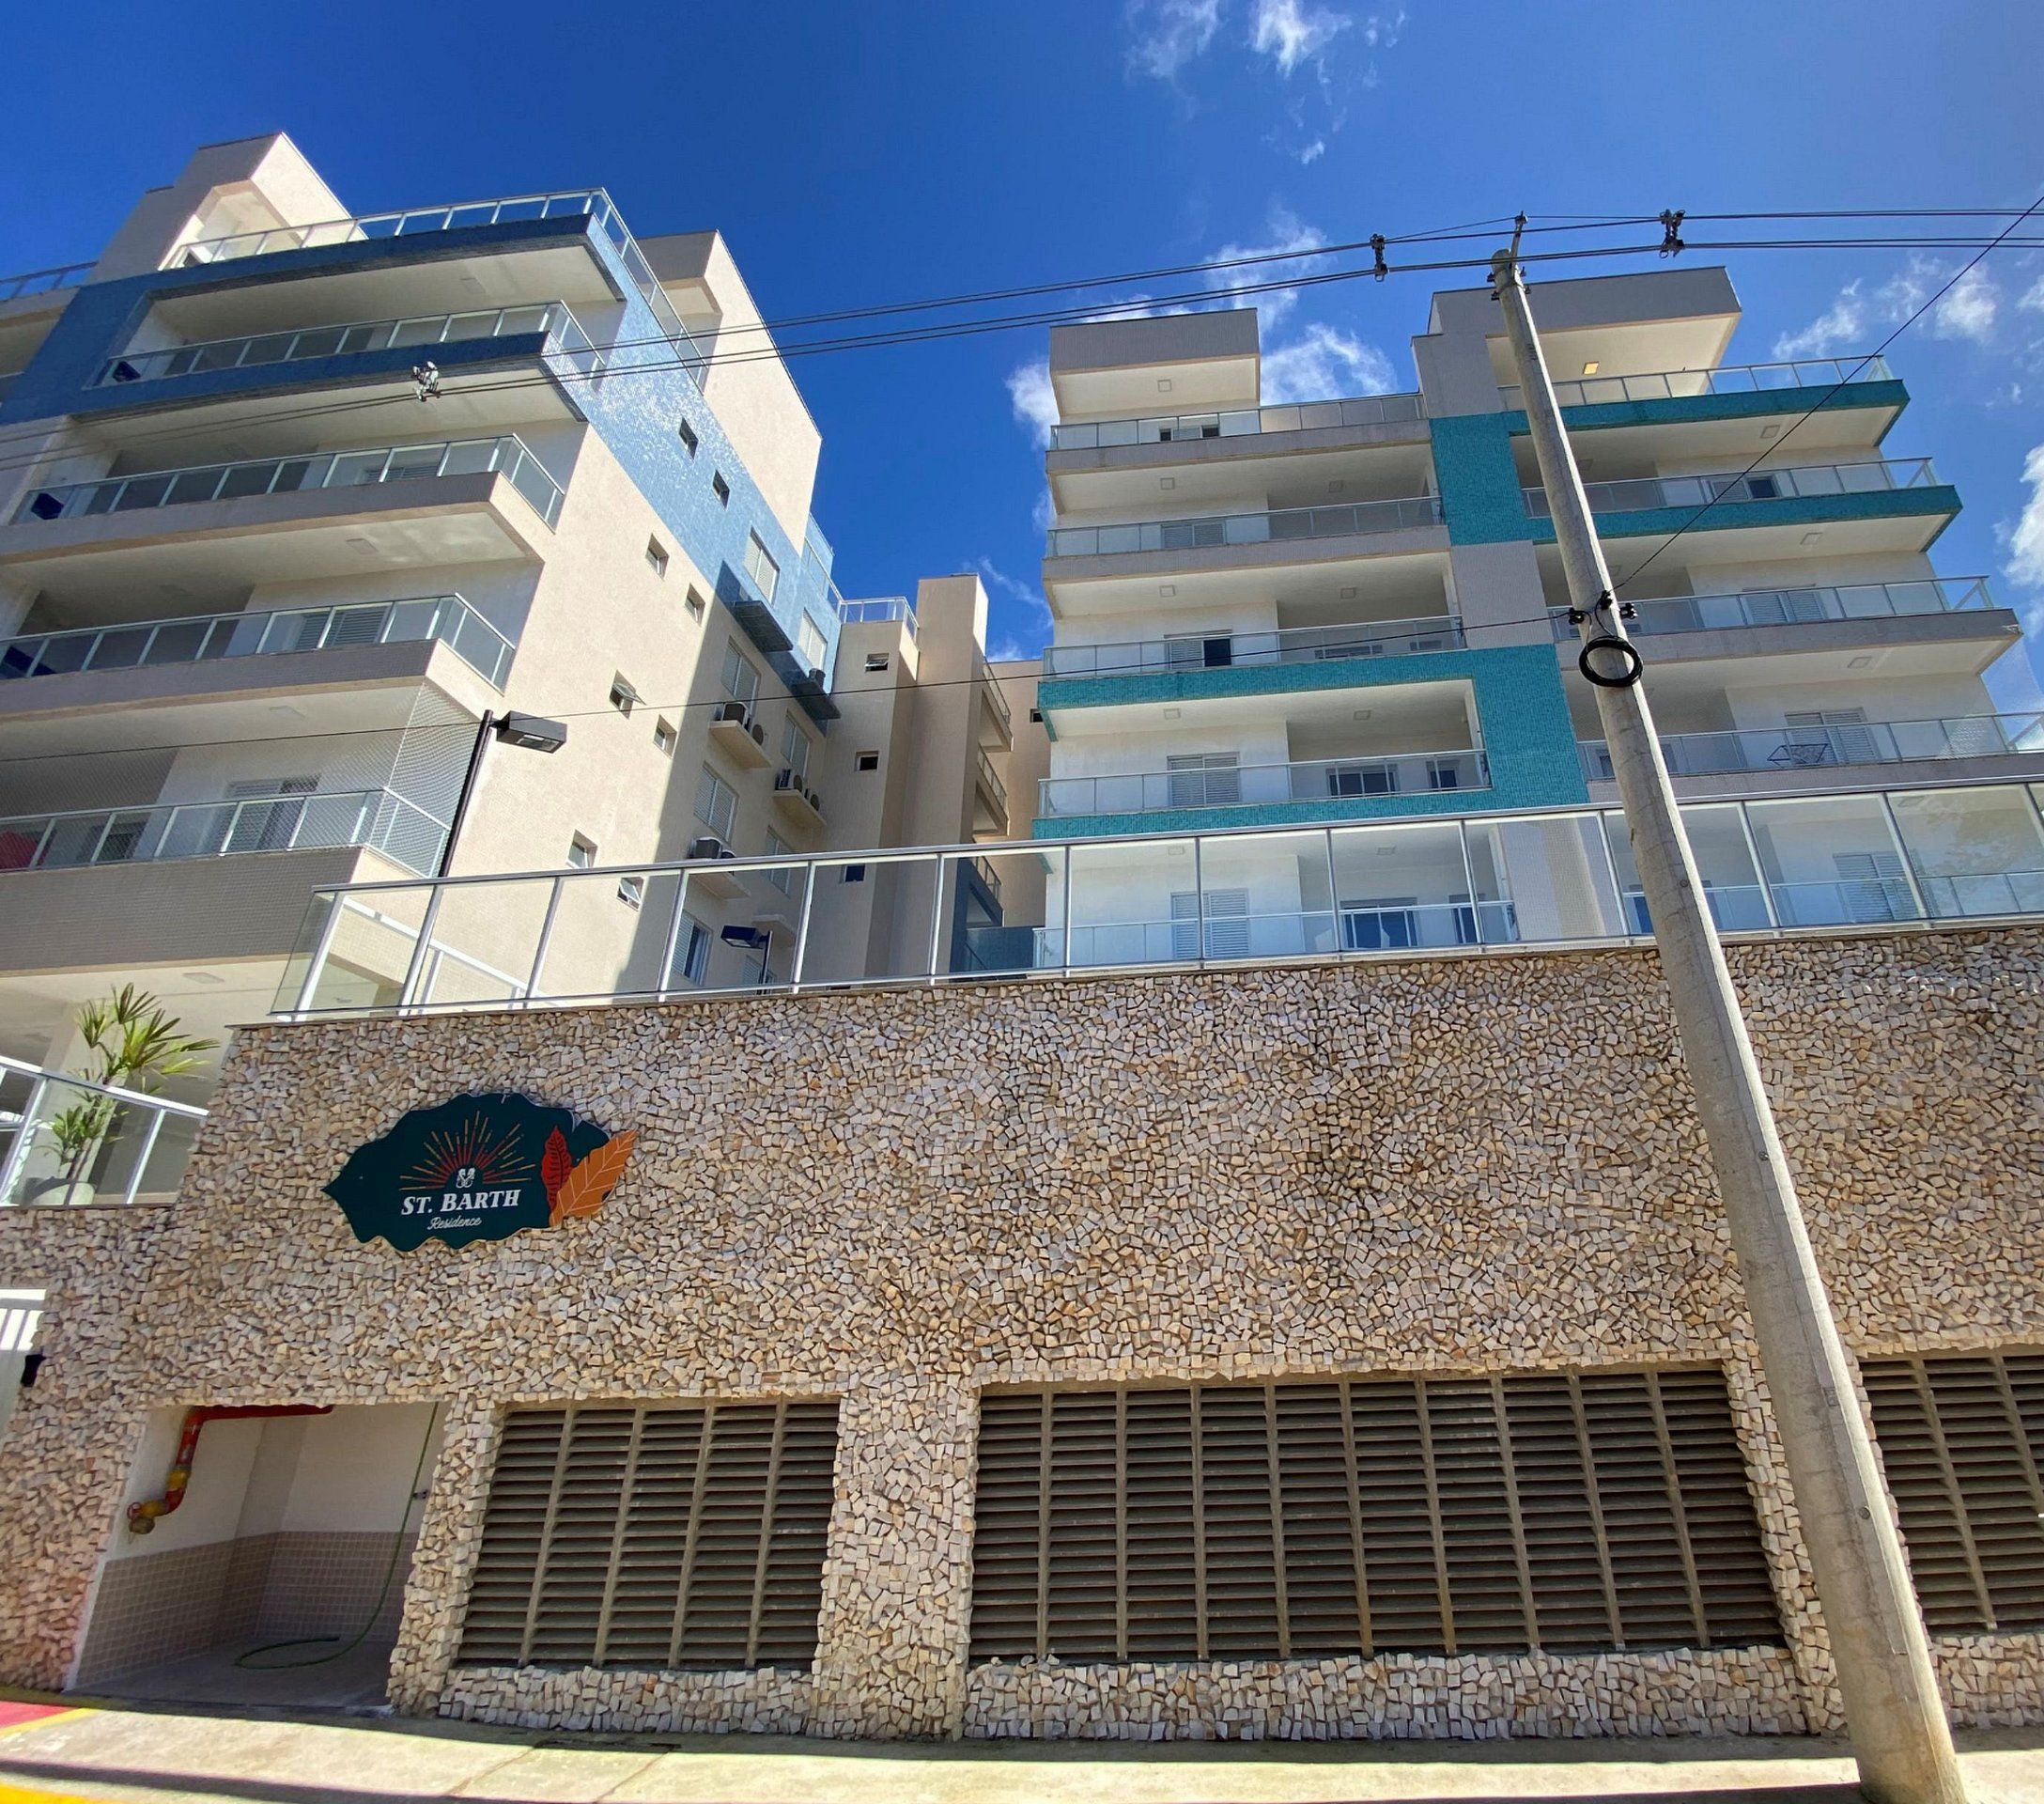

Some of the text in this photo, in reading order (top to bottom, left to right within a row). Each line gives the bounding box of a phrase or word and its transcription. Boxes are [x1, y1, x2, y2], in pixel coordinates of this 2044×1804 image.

[400, 1189, 521, 1216] ST. BARTH
[426, 1215, 483, 1231] Residence
